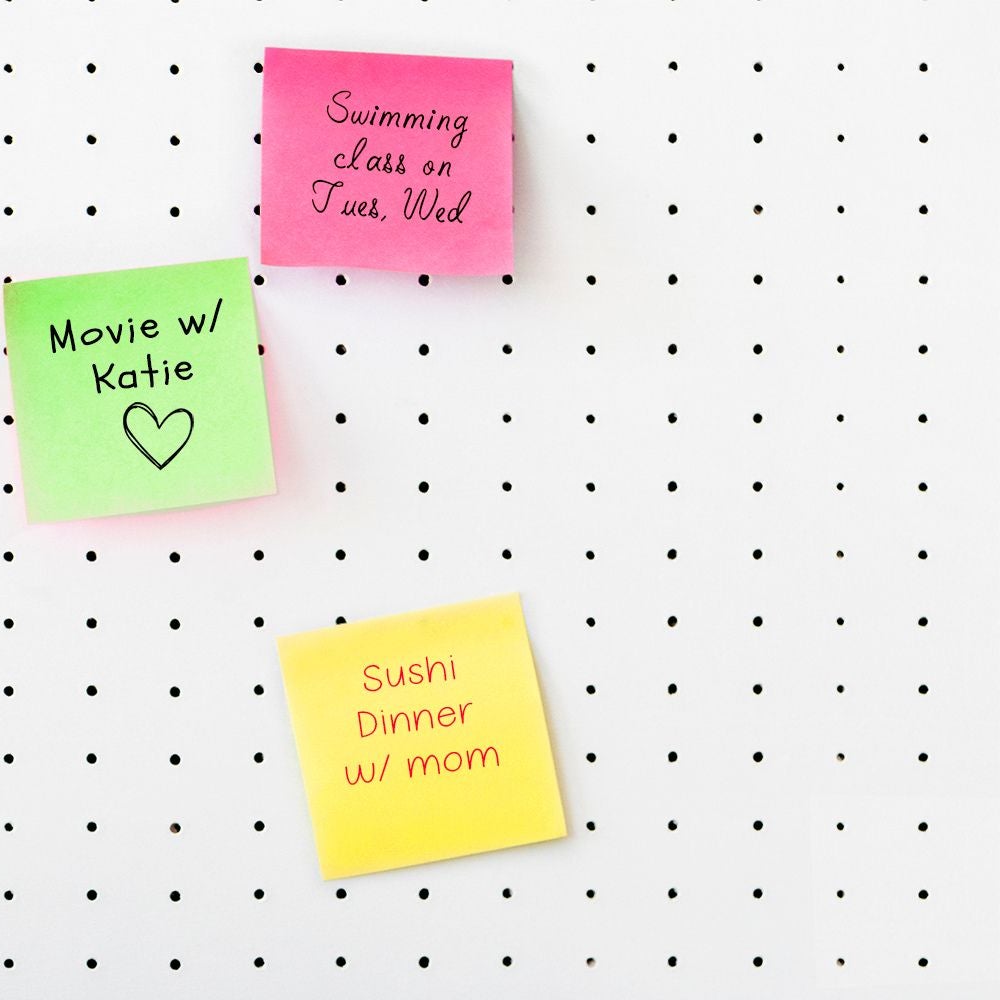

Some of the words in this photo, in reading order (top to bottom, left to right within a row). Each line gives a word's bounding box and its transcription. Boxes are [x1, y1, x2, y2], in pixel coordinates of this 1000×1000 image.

[326, 90, 469, 148] Swimming
[333, 136, 407, 175] class
[422, 159, 452, 178] on
[311, 179, 387, 222] Tues,
[403, 187, 473, 224] Wed
[49, 317, 160, 354] Movie
[177, 297, 224, 336] w/
[91, 353, 194, 395] Katie
[363, 654, 456, 692] Sushi
[357, 702, 473, 738] Dinner
[344, 753, 390, 786] w/
[407, 746, 500, 779] mom
